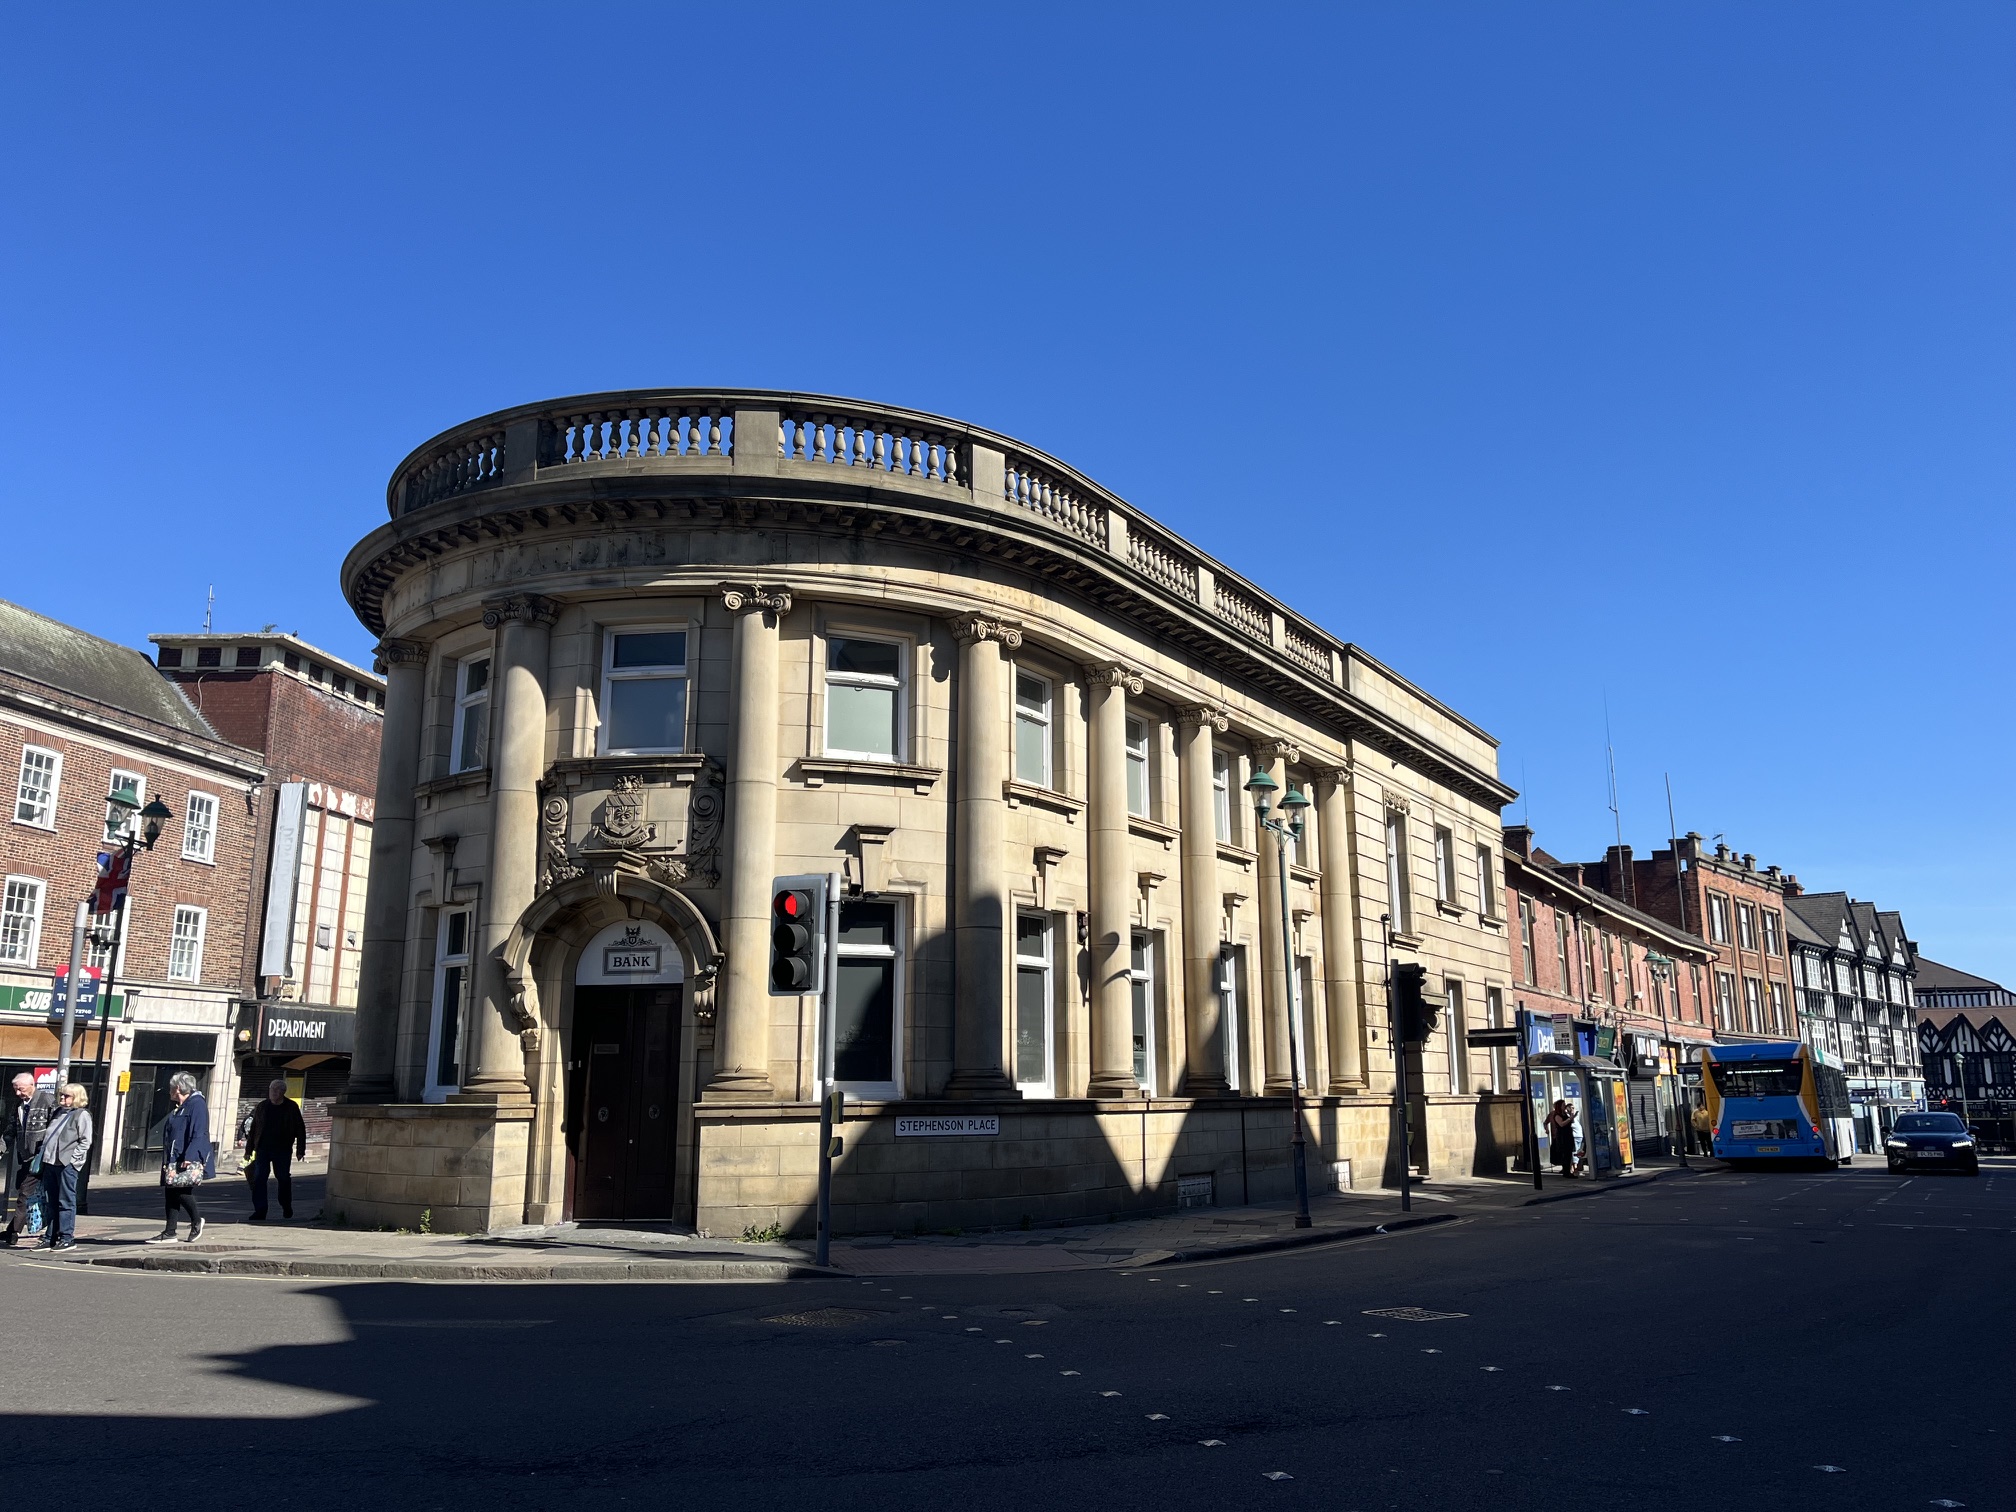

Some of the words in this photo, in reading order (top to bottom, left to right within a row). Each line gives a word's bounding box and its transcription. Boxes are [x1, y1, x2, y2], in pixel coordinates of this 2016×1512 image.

[613, 956, 651, 967] BANK
[19, 991, 52, 1010] SUB
[268, 1018, 326, 1039] DEPARTMENT
[900, 1120, 964, 1131] STEPHENSON
[968, 1119, 996, 1130] PLACE
